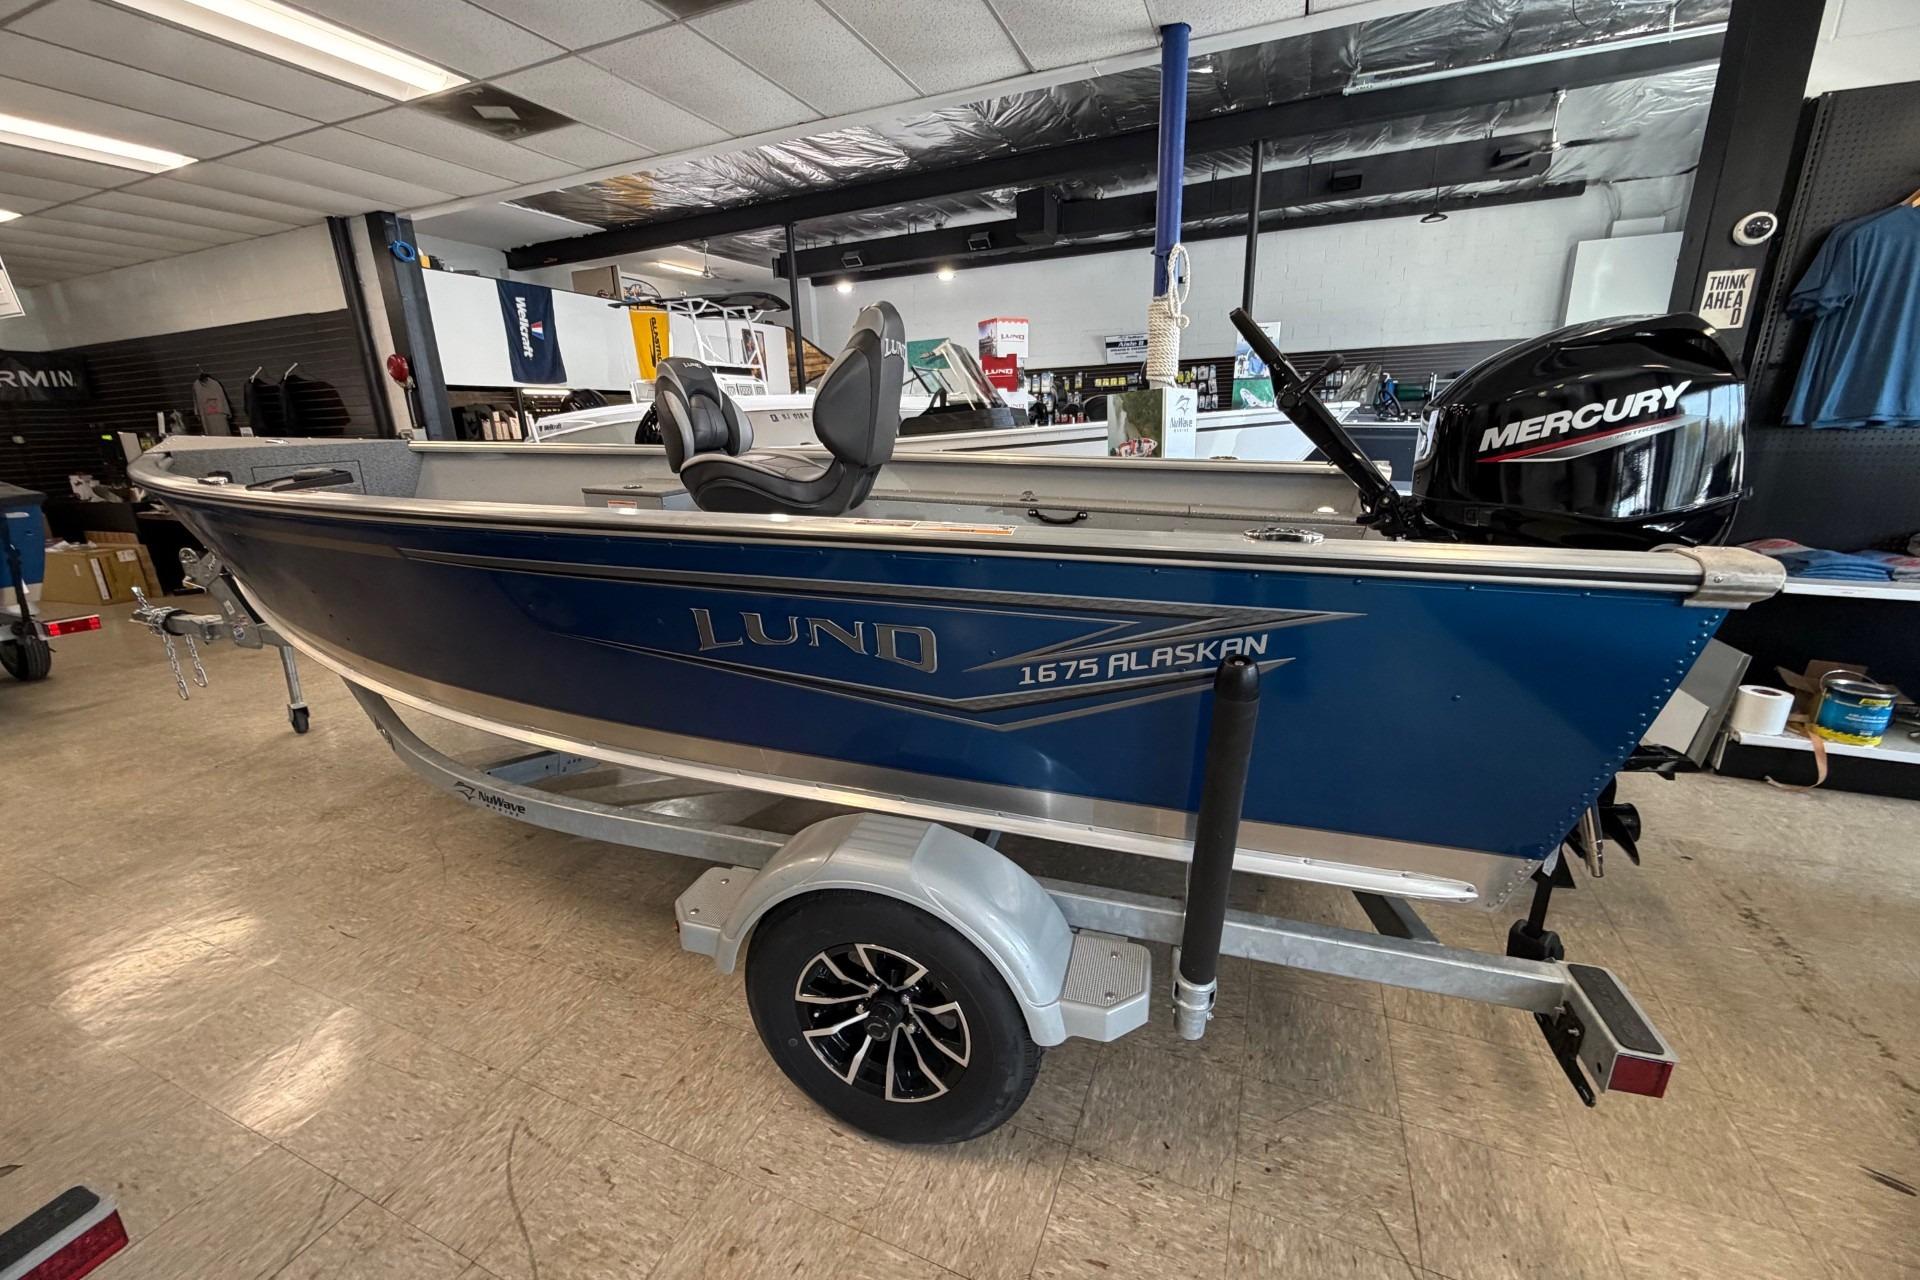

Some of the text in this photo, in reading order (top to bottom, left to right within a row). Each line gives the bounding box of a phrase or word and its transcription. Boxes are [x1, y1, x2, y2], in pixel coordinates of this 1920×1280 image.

[1710, 274, 1749, 290] THINK
[515, 297, 534, 358] Wellcraft
[884, 338, 905, 359] LUN
[985, 368, 1014, 376] LUND
[1478, 380, 1692, 453] MERCURY
[689, 608, 938, 674] LUND
[1018, 634, 1268, 685] 1675 ALASKAN
[478, 790, 527, 815] NuWave
